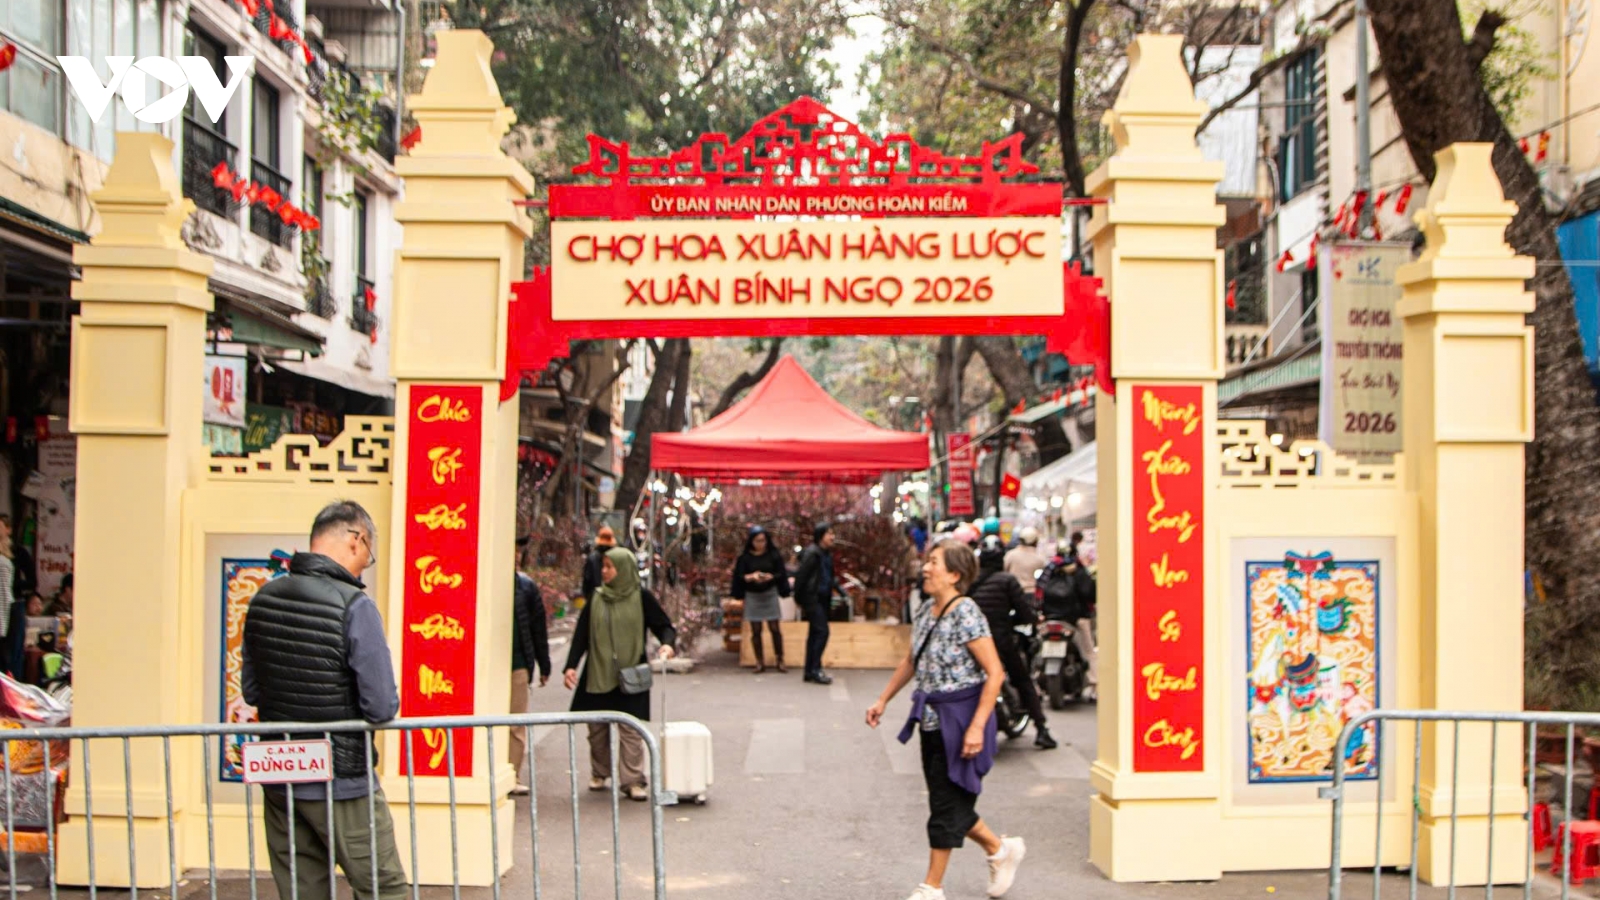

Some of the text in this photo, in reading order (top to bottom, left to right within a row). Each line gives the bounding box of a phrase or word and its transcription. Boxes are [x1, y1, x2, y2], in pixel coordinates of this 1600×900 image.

[651, 191, 967, 212] ỦY BAN NHÂN DÂN PHƯỜNG HOÀN KIẾM
[567, 225, 1046, 265] CHỢ HOA XUÂN HÀNG LƯỢC
[625, 270, 994, 307] XUÂN BÍNH NGỌ 2026
[417, 394, 472, 423] Chúc
[1344, 412, 1396, 433] 2026
[249, 756, 325, 774] DỪNG LẠI
